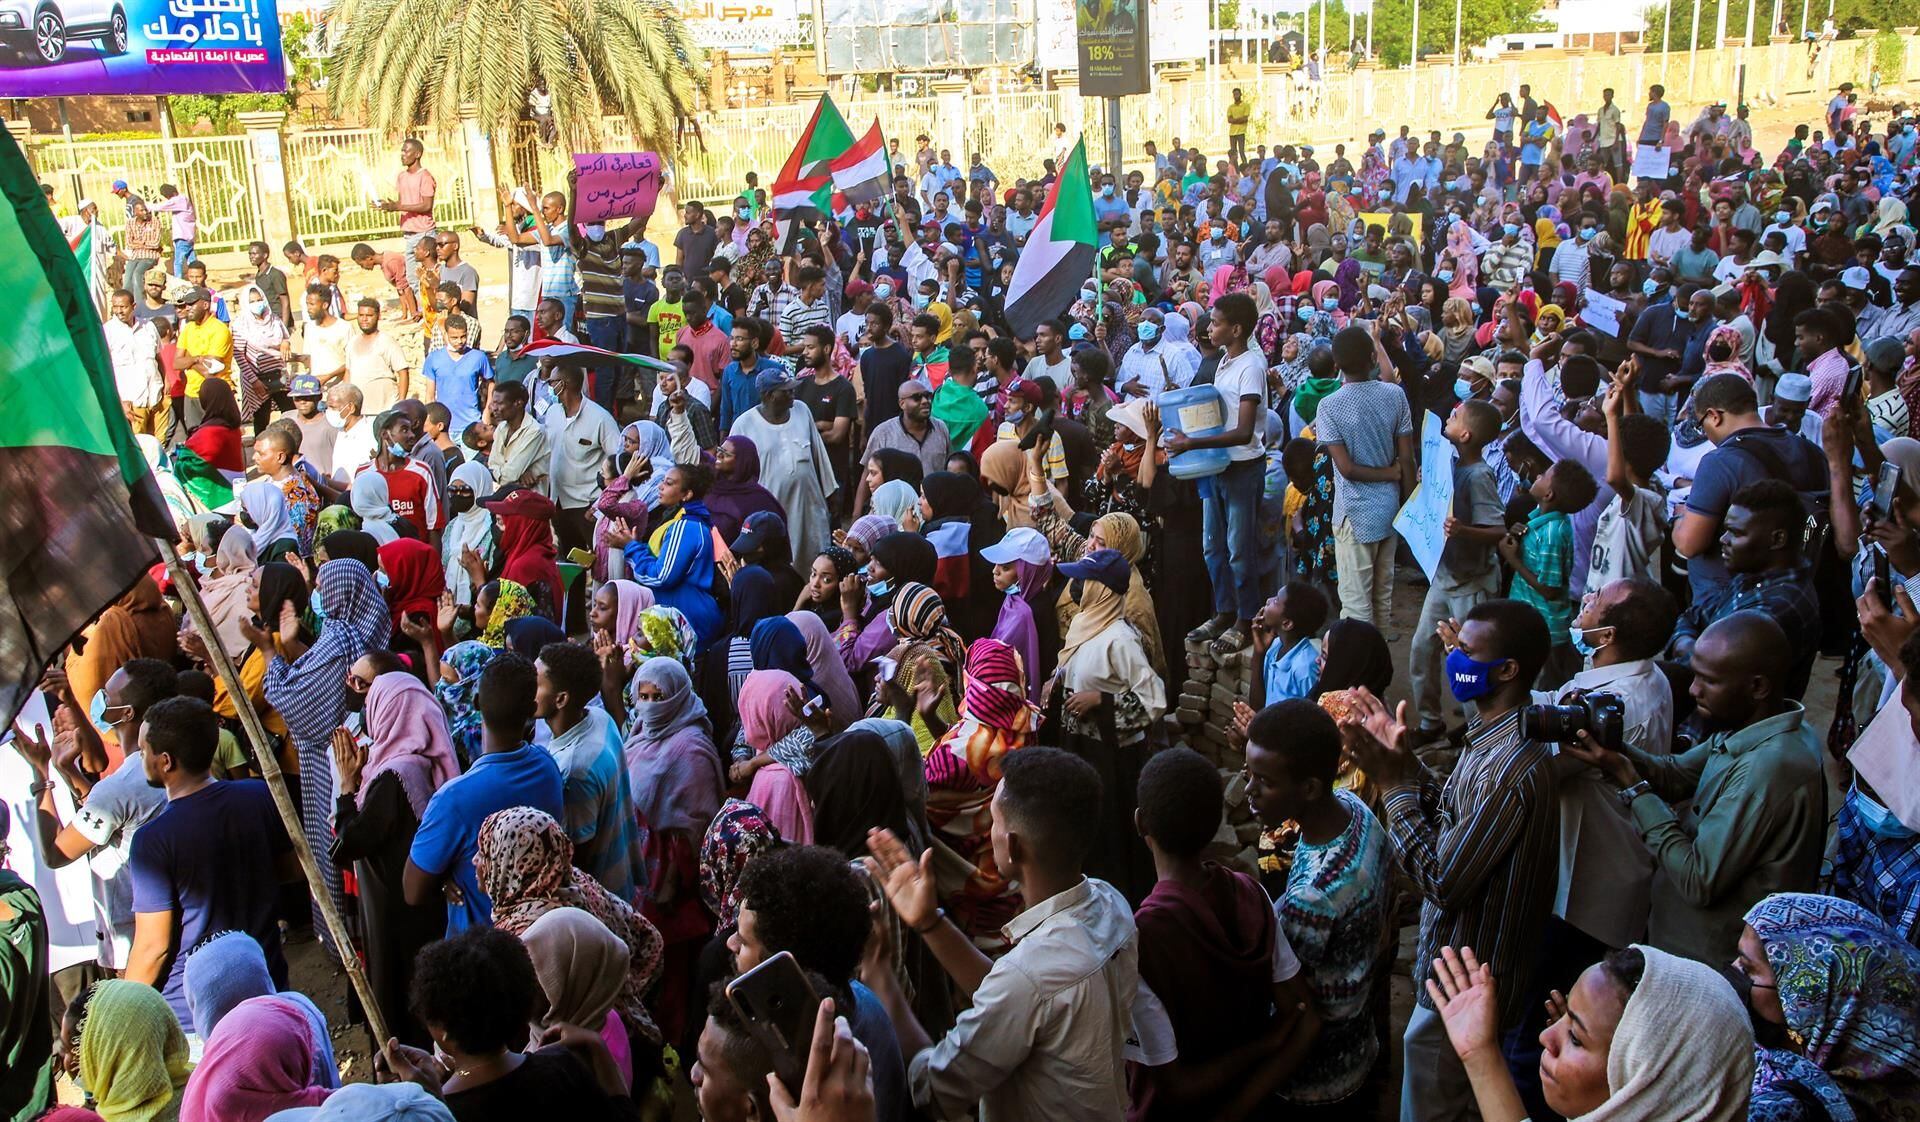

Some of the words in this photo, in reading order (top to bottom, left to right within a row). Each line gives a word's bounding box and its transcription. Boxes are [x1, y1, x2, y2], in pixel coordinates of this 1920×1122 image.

[143, 13, 263, 46] بأحلامك
[234, 51, 265, 62] عصرية
[1088, 46, 1114, 60] 18%
[587, 188, 610, 203] من
[392, 499, 414, 510] Bau
[1455, 672, 1478, 683] MRF
